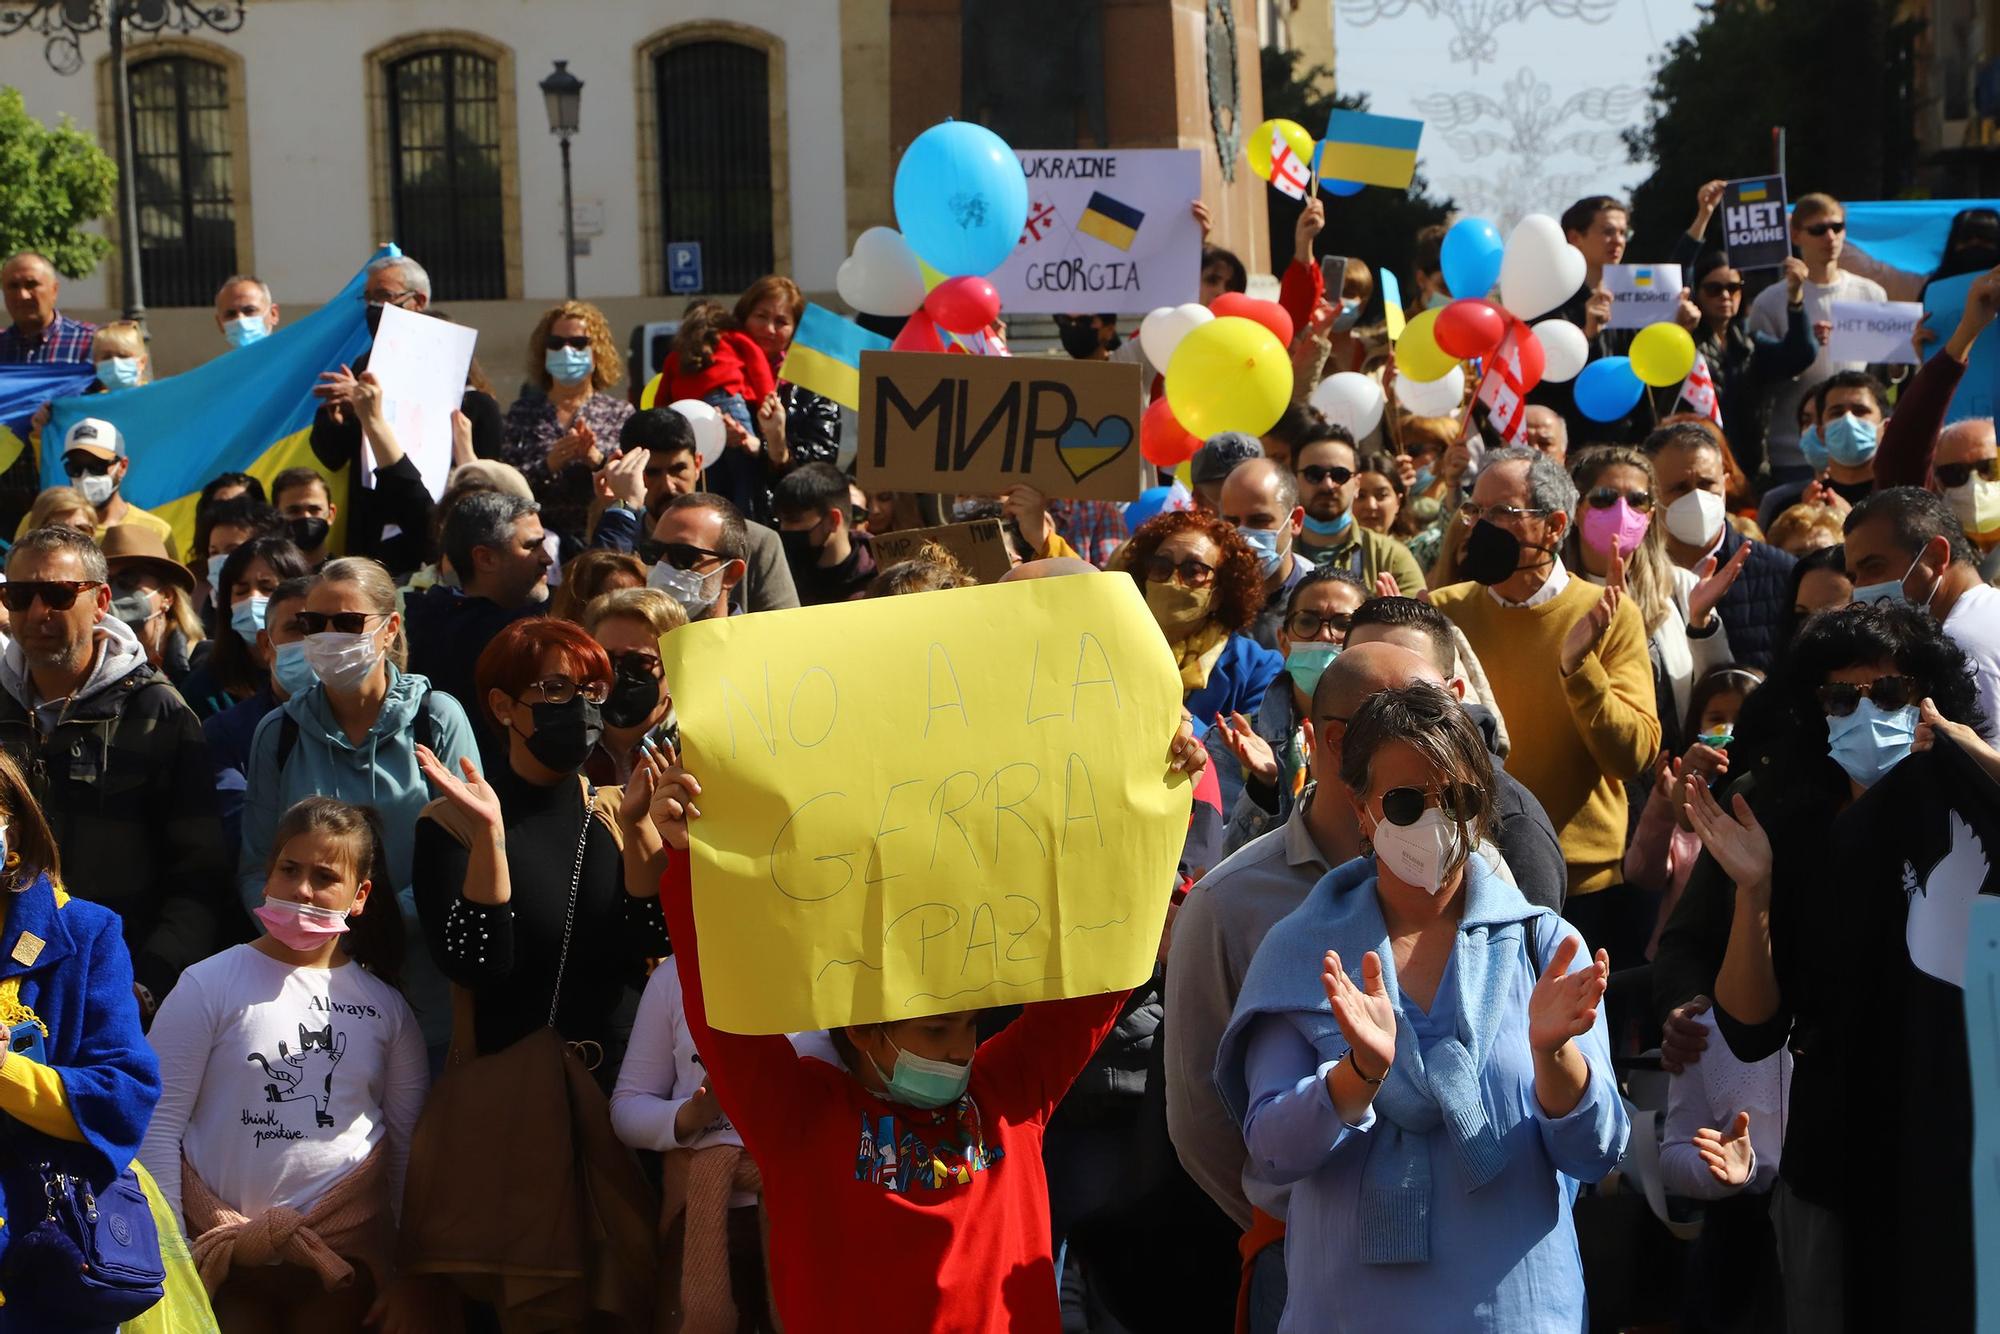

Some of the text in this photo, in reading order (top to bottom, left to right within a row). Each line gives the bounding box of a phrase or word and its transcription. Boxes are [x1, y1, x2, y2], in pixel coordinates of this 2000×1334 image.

[1022, 157, 1116, 178] UKRAINE
[1726, 201, 1781, 231] НЕТ
[1728, 226, 1784, 246] ВОЙНЕ
[677, 249, 691, 269] P
[1026, 257, 1141, 291] GEORGIA
[1837, 320, 1863, 332] НЕТ
[873, 376, 1078, 474] МИР
[721, 632, 1121, 759] NO A LA
[770, 752, 1104, 902] GERRA
[884, 894, 1042, 976] PAZ
[308, 995, 382, 1020] Always,
[254, 1124, 309, 1149] positive.
